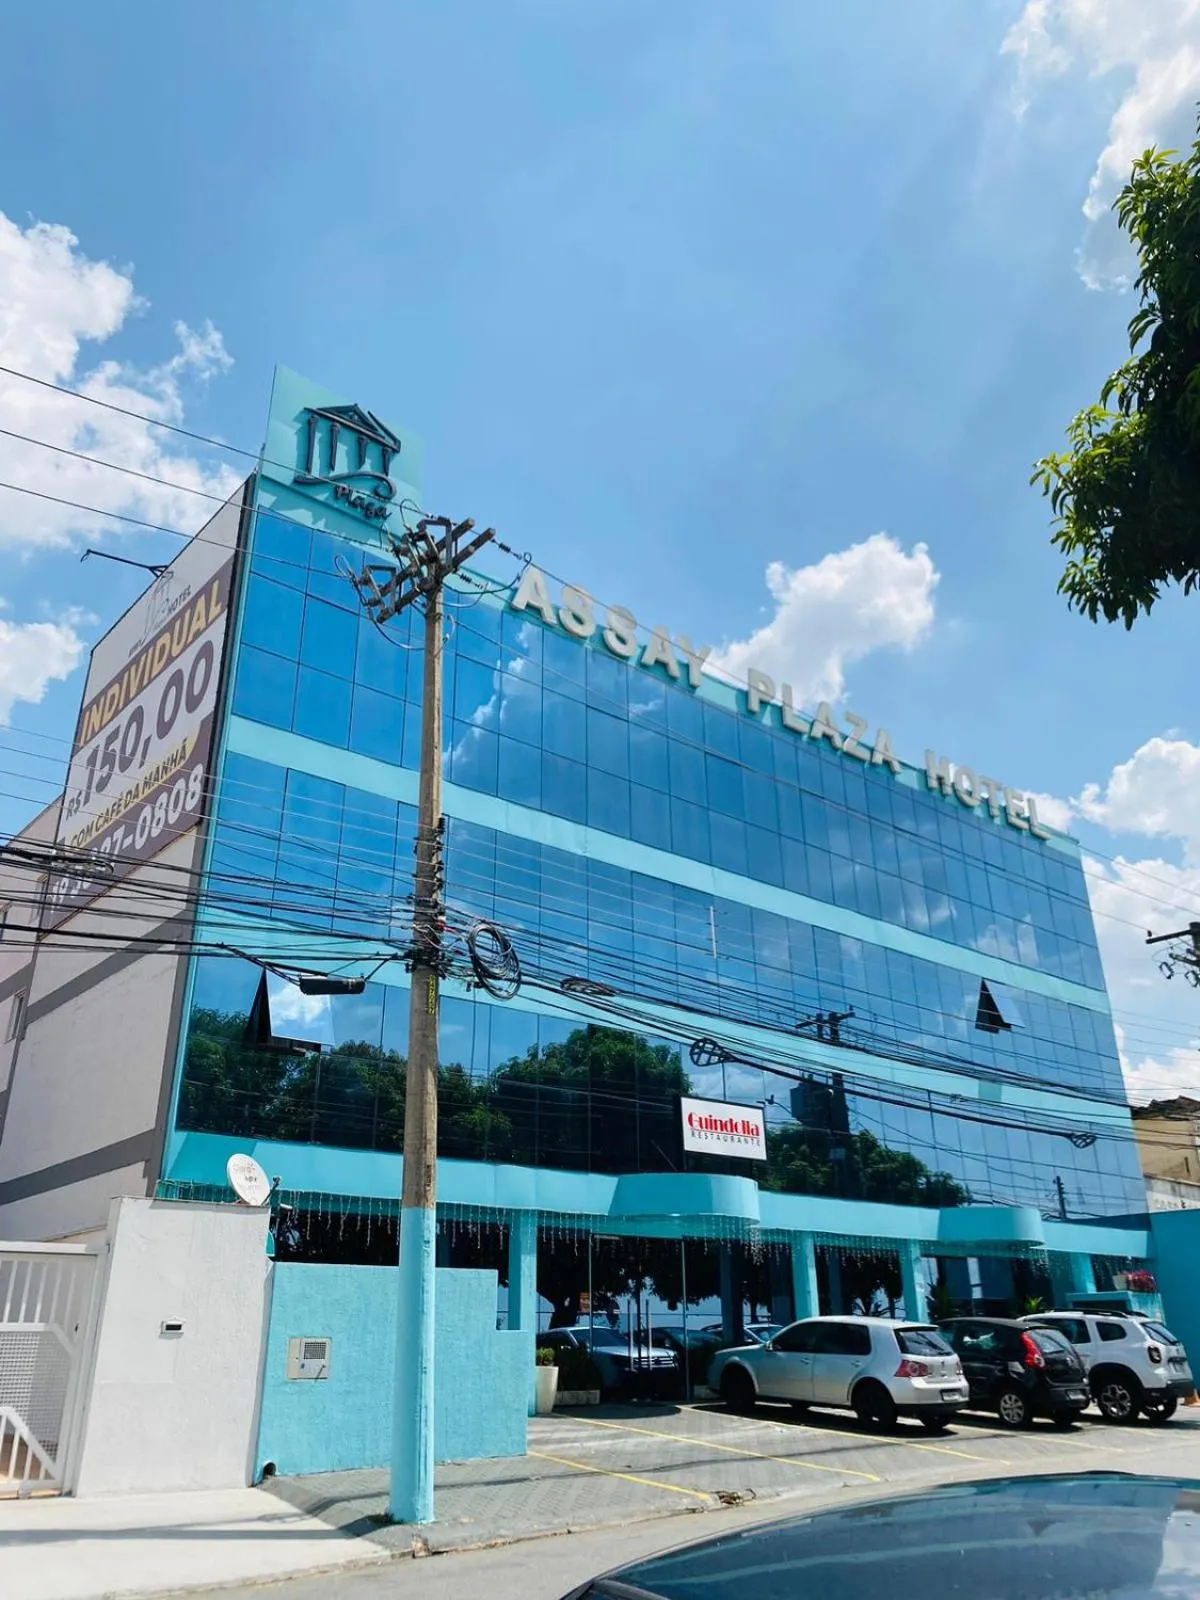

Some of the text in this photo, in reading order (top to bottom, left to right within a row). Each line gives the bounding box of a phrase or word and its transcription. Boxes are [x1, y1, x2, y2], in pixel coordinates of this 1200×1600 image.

[79, 580, 222, 746] INDIVIDUAL
[510, 567, 1052, 840] ASSAY PLAZA HOTEL
[123, 783, 140, 809] DA
[690, 1130, 760, 1147] RESTAURANTE
